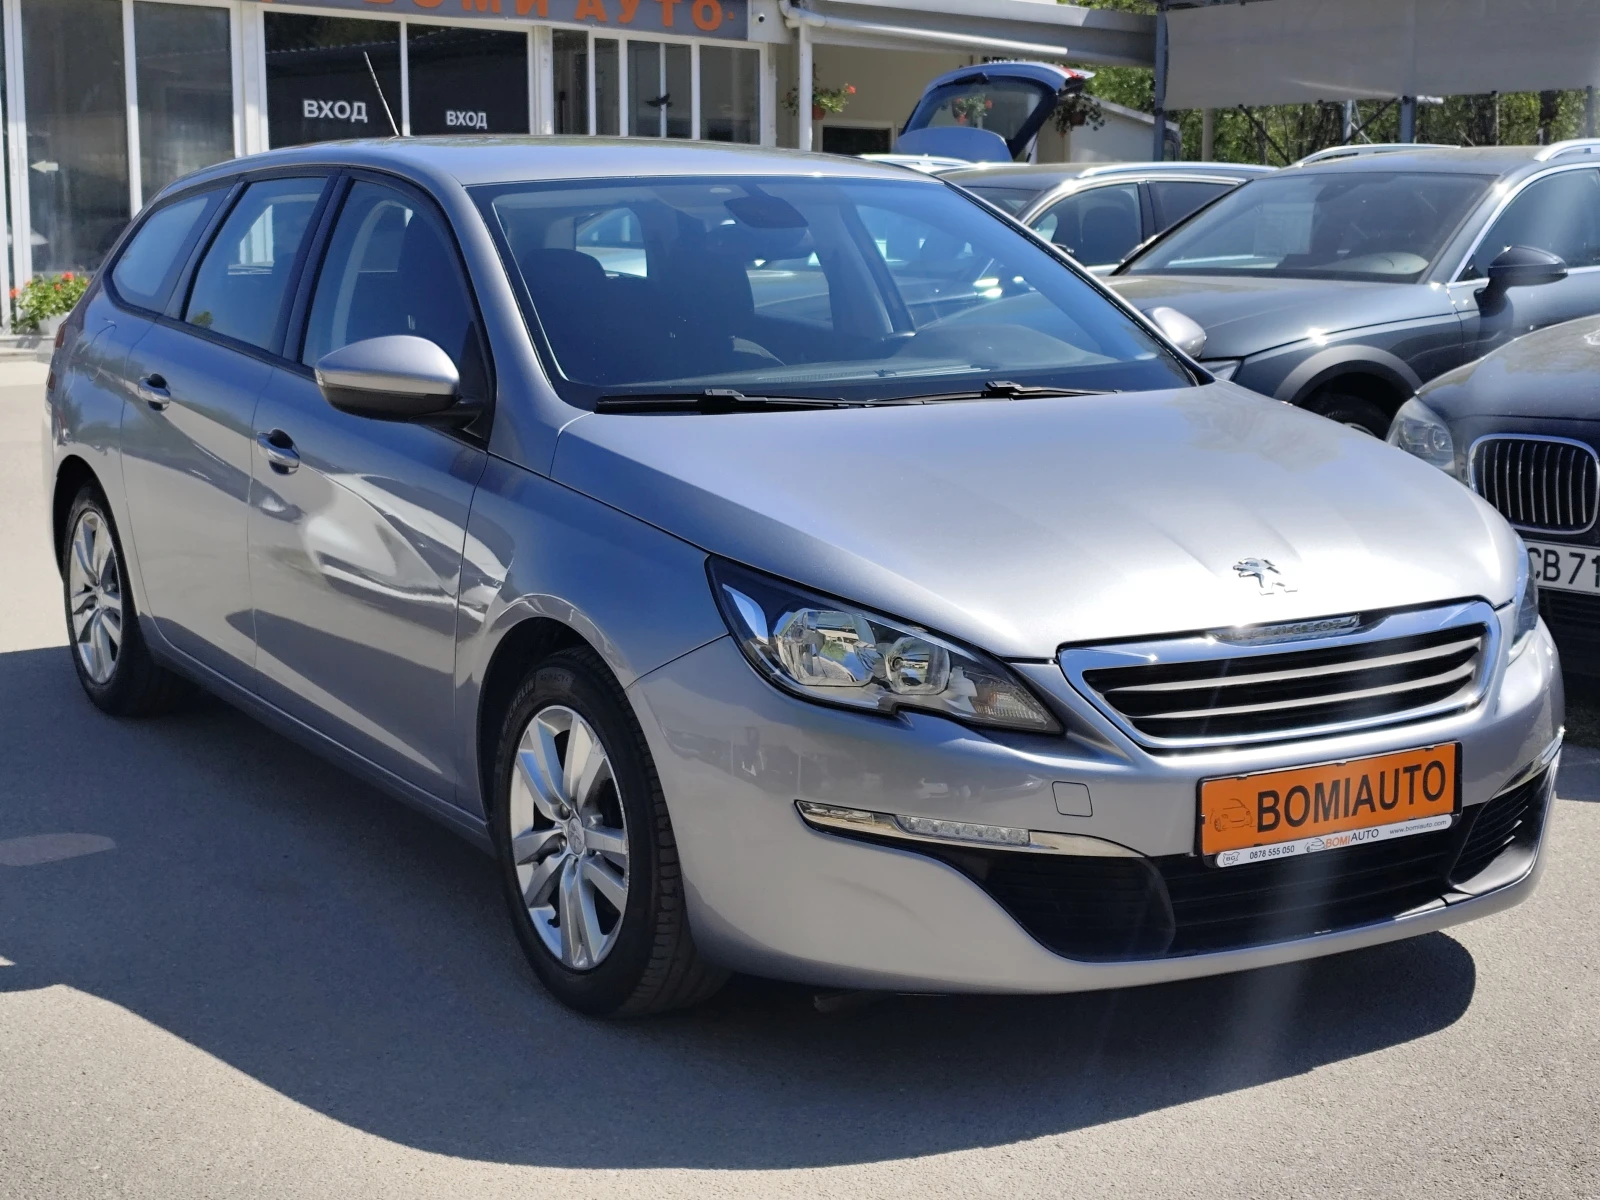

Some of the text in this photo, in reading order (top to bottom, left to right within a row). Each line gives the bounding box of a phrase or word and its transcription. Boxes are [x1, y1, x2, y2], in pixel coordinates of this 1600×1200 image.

[303, 99, 368, 124] ВХОД
[446, 111, 488, 130] ВХОД
[1257, 760, 1446, 834] BOMIAUTO
[1249, 850, 1266, 860] 0878
[1268, 848, 1281, 857] 555
[1282, 845, 1295, 854] 050
[1389, 820, 1447, 835] www.bomiauto.com
